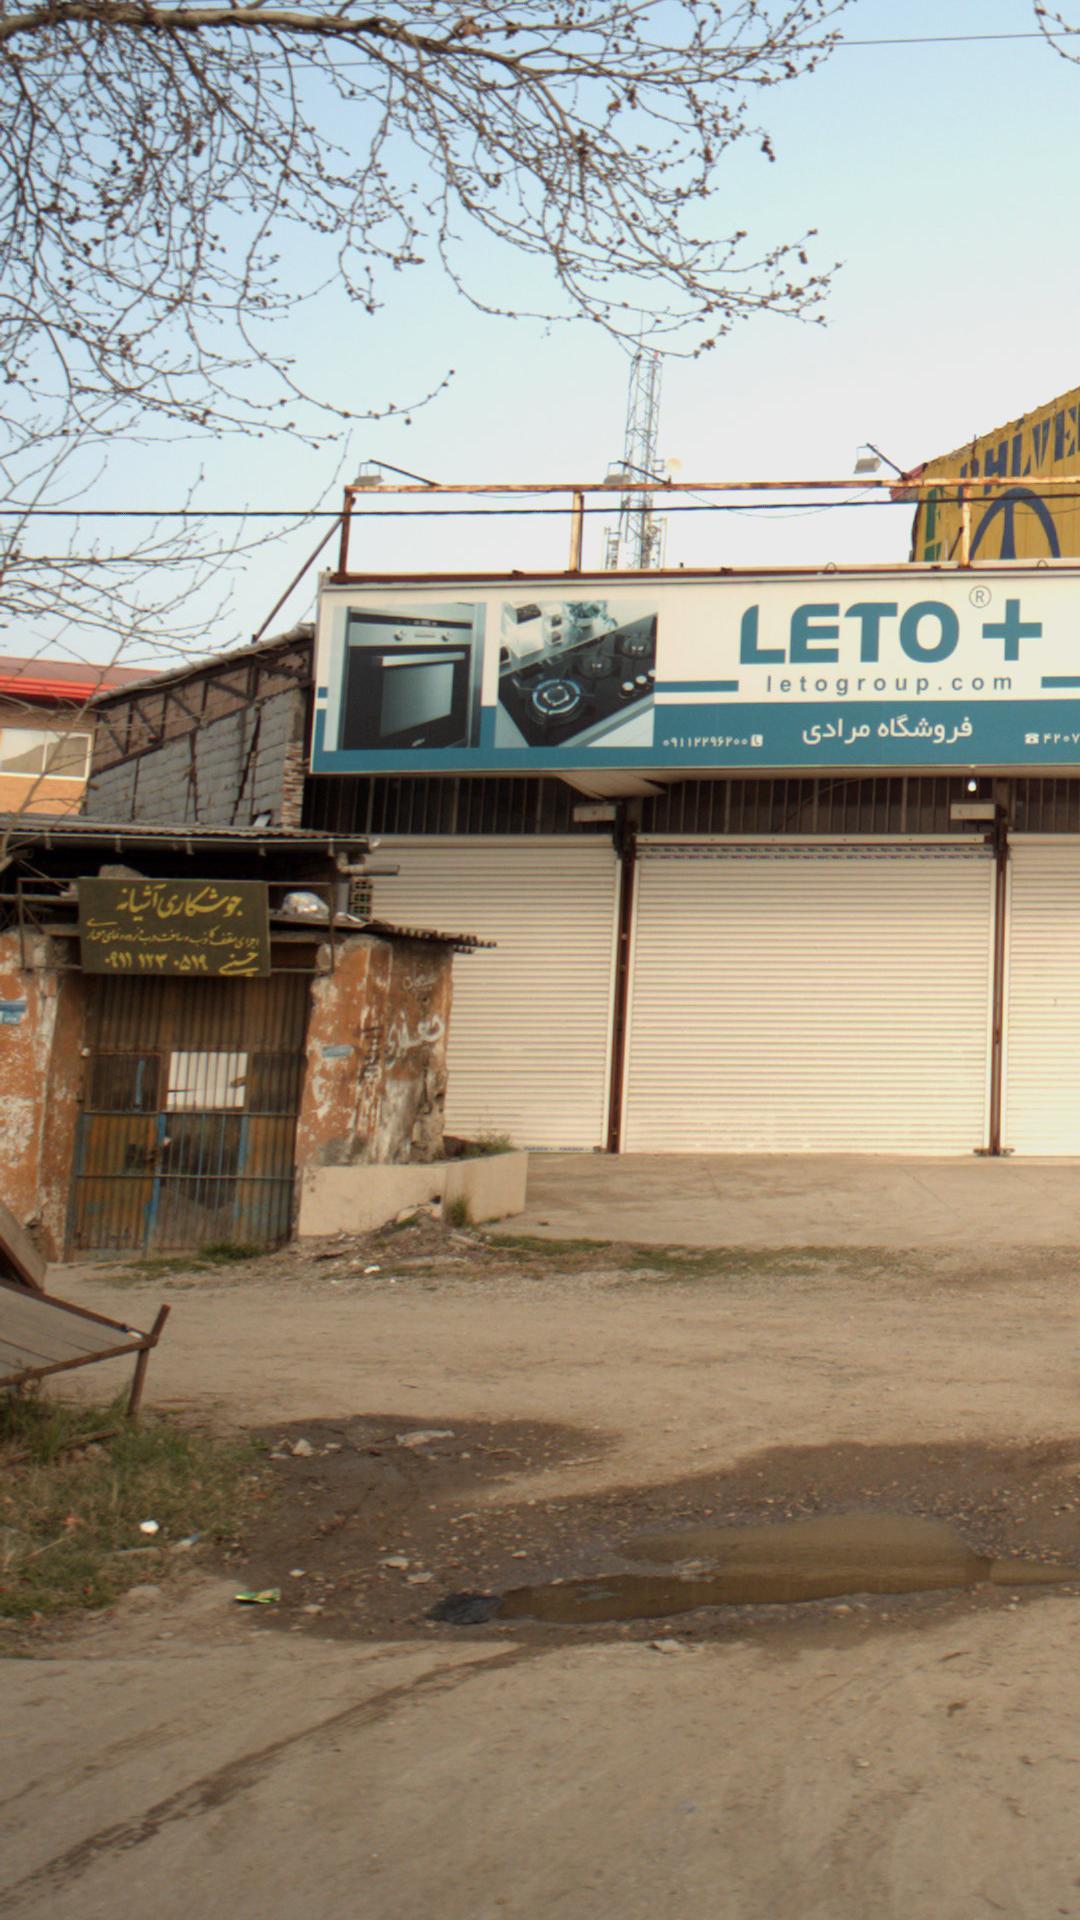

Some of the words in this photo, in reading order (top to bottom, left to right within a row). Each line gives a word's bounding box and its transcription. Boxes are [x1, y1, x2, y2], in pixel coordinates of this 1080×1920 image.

[740, 600, 960, 665] LETO
[766, 674, 1013, 696] letogroup.com
[802, 717, 872, 745] مرادی
[877, 714, 974, 744] فروشگاه
[115, 883, 168, 923] آشیانه
[156, 886, 244, 919] جوشکاری
[105, 951, 132, 969] ۰۹۱۱
